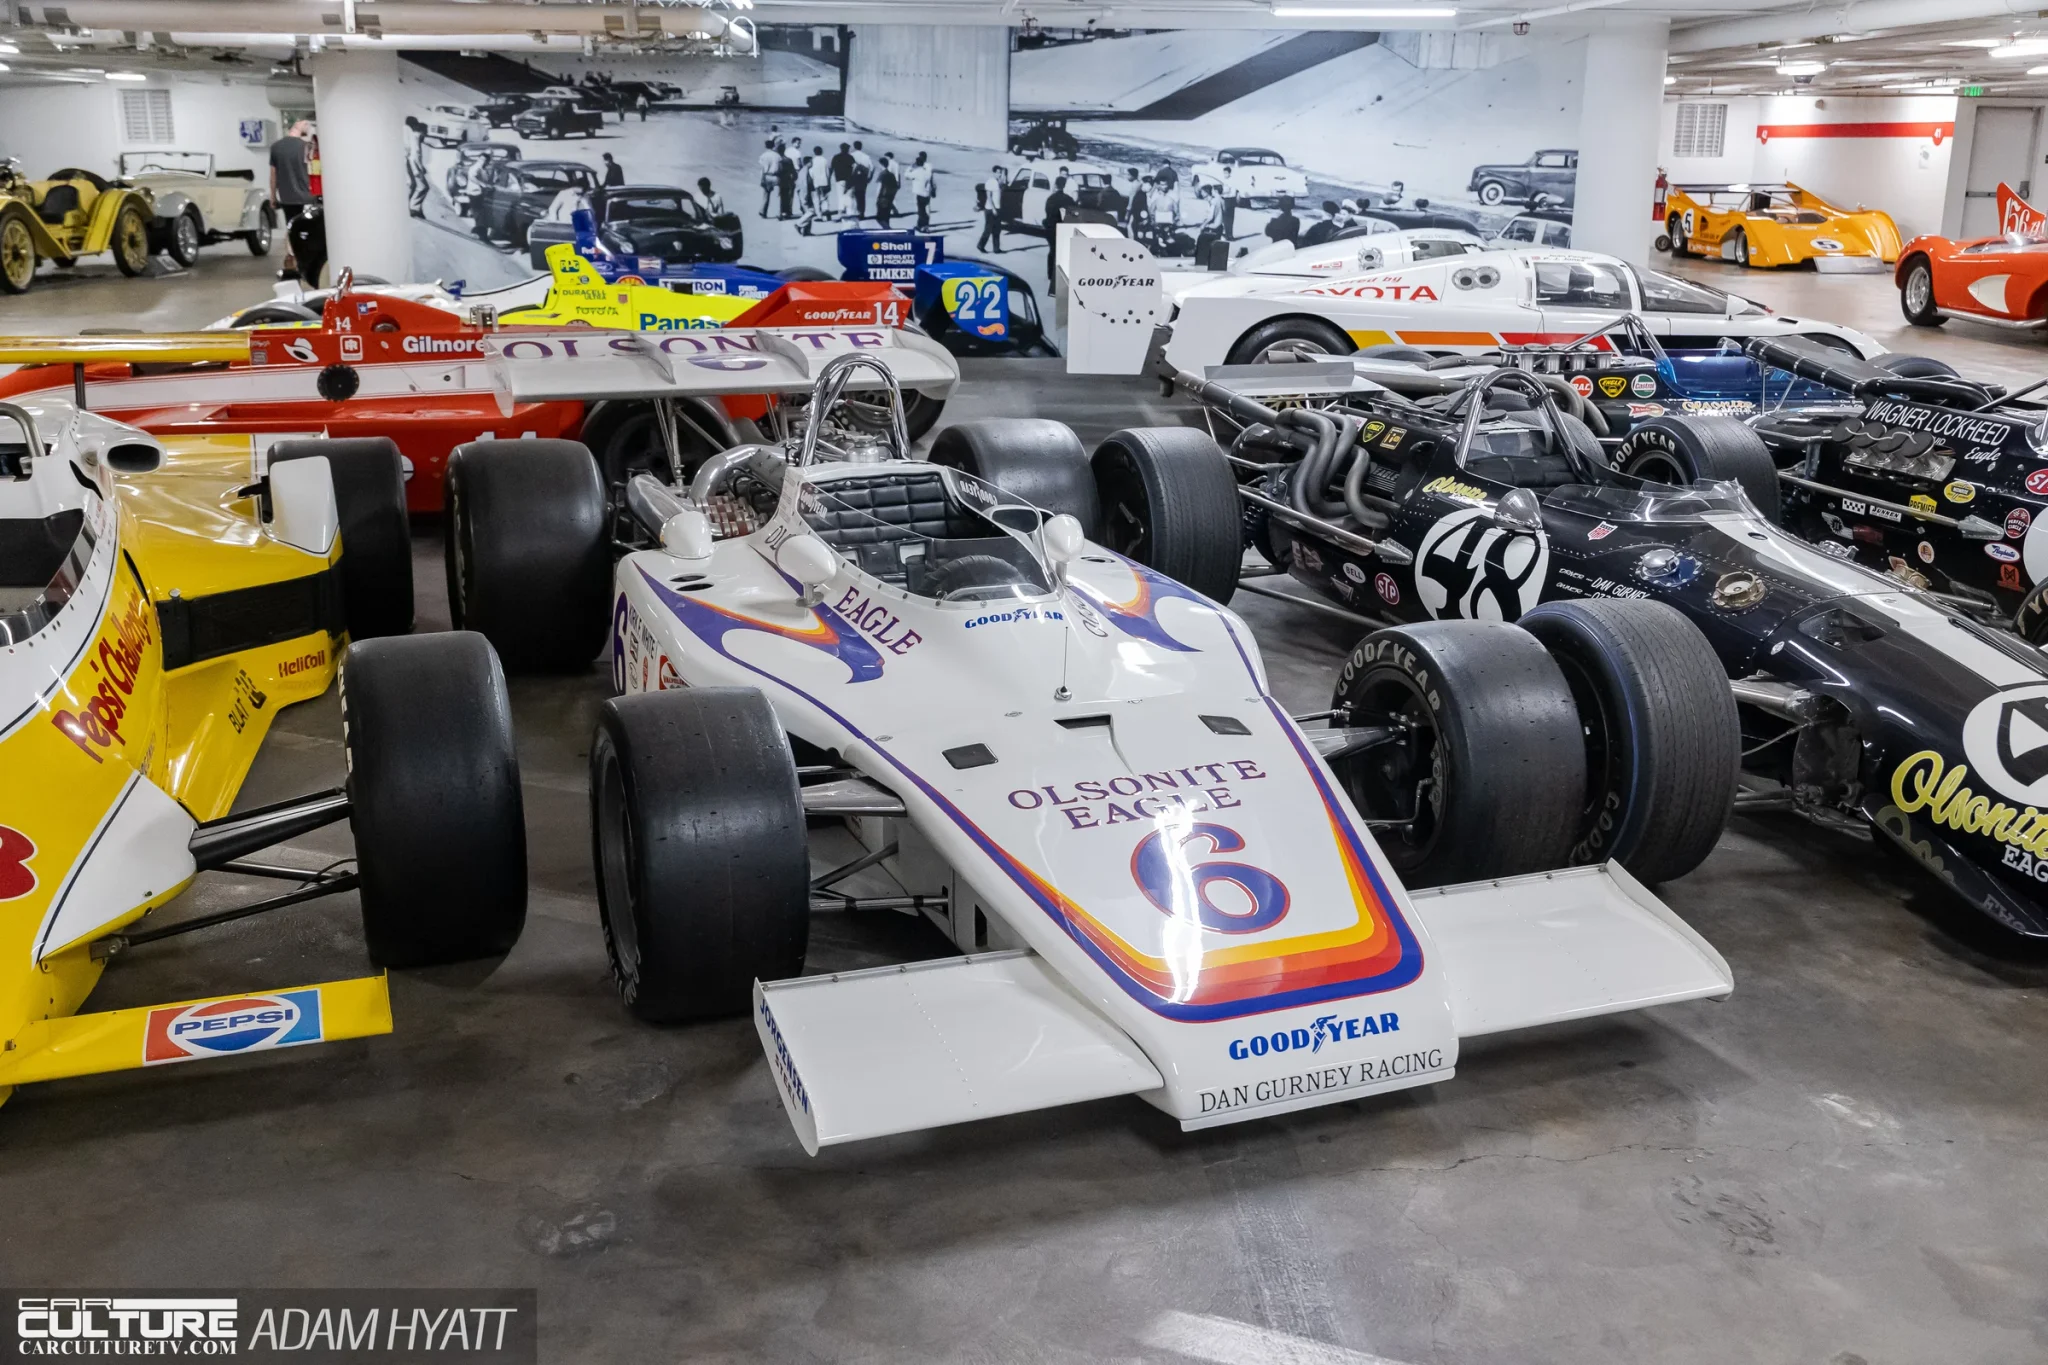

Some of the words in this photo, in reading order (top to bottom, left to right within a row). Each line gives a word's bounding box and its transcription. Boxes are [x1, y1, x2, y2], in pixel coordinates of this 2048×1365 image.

[1684, 213, 1693, 233] 5
[924, 242, 937, 265] 7
[1816, 240, 1838, 249] 5
[868, 268, 915, 279] TIMKEN
[874, 301, 899, 326] 14
[958, 283, 1001, 319] 22
[335, 316, 351, 332] 14
[640, 313, 728, 331] Panas
[403, 335, 486, 354] Gilmore
[1865, 400, 1931, 429] WAGNER
[1923, 412, 2011, 447] LOCKHEED
[1610, 432, 1676, 474] OODYEAR
[1964, 446, 2002, 466] Eagle
[1345, 566, 1364, 581] BELL
[1422, 515, 1541, 622] 48
[1559, 568, 1585, 580] DRIVER
[1591, 577, 1615, 592] DAN
[1612, 584, 1651, 600] GURNEY
[1378, 576, 1397, 599] STP
[833, 586, 923, 656] EAGLE
[613, 591, 628, 696] 6
[228, 697, 249, 735] BLAT
[1007, 758, 1267, 810] OLSONITE
[1059, 786, 1242, 831] EAGLE
[1890, 750, 2048, 861] Olsonite
[1130, 821, 1291, 935] 6
[174, 1008, 294, 1036] PEPSI
[759, 998, 809, 1115] JORGENSEN
[1200, 1082, 1250, 1114] DAN
[1255, 1064, 1354, 1103] GURNEY
[1359, 1048, 1444, 1083] RACING
